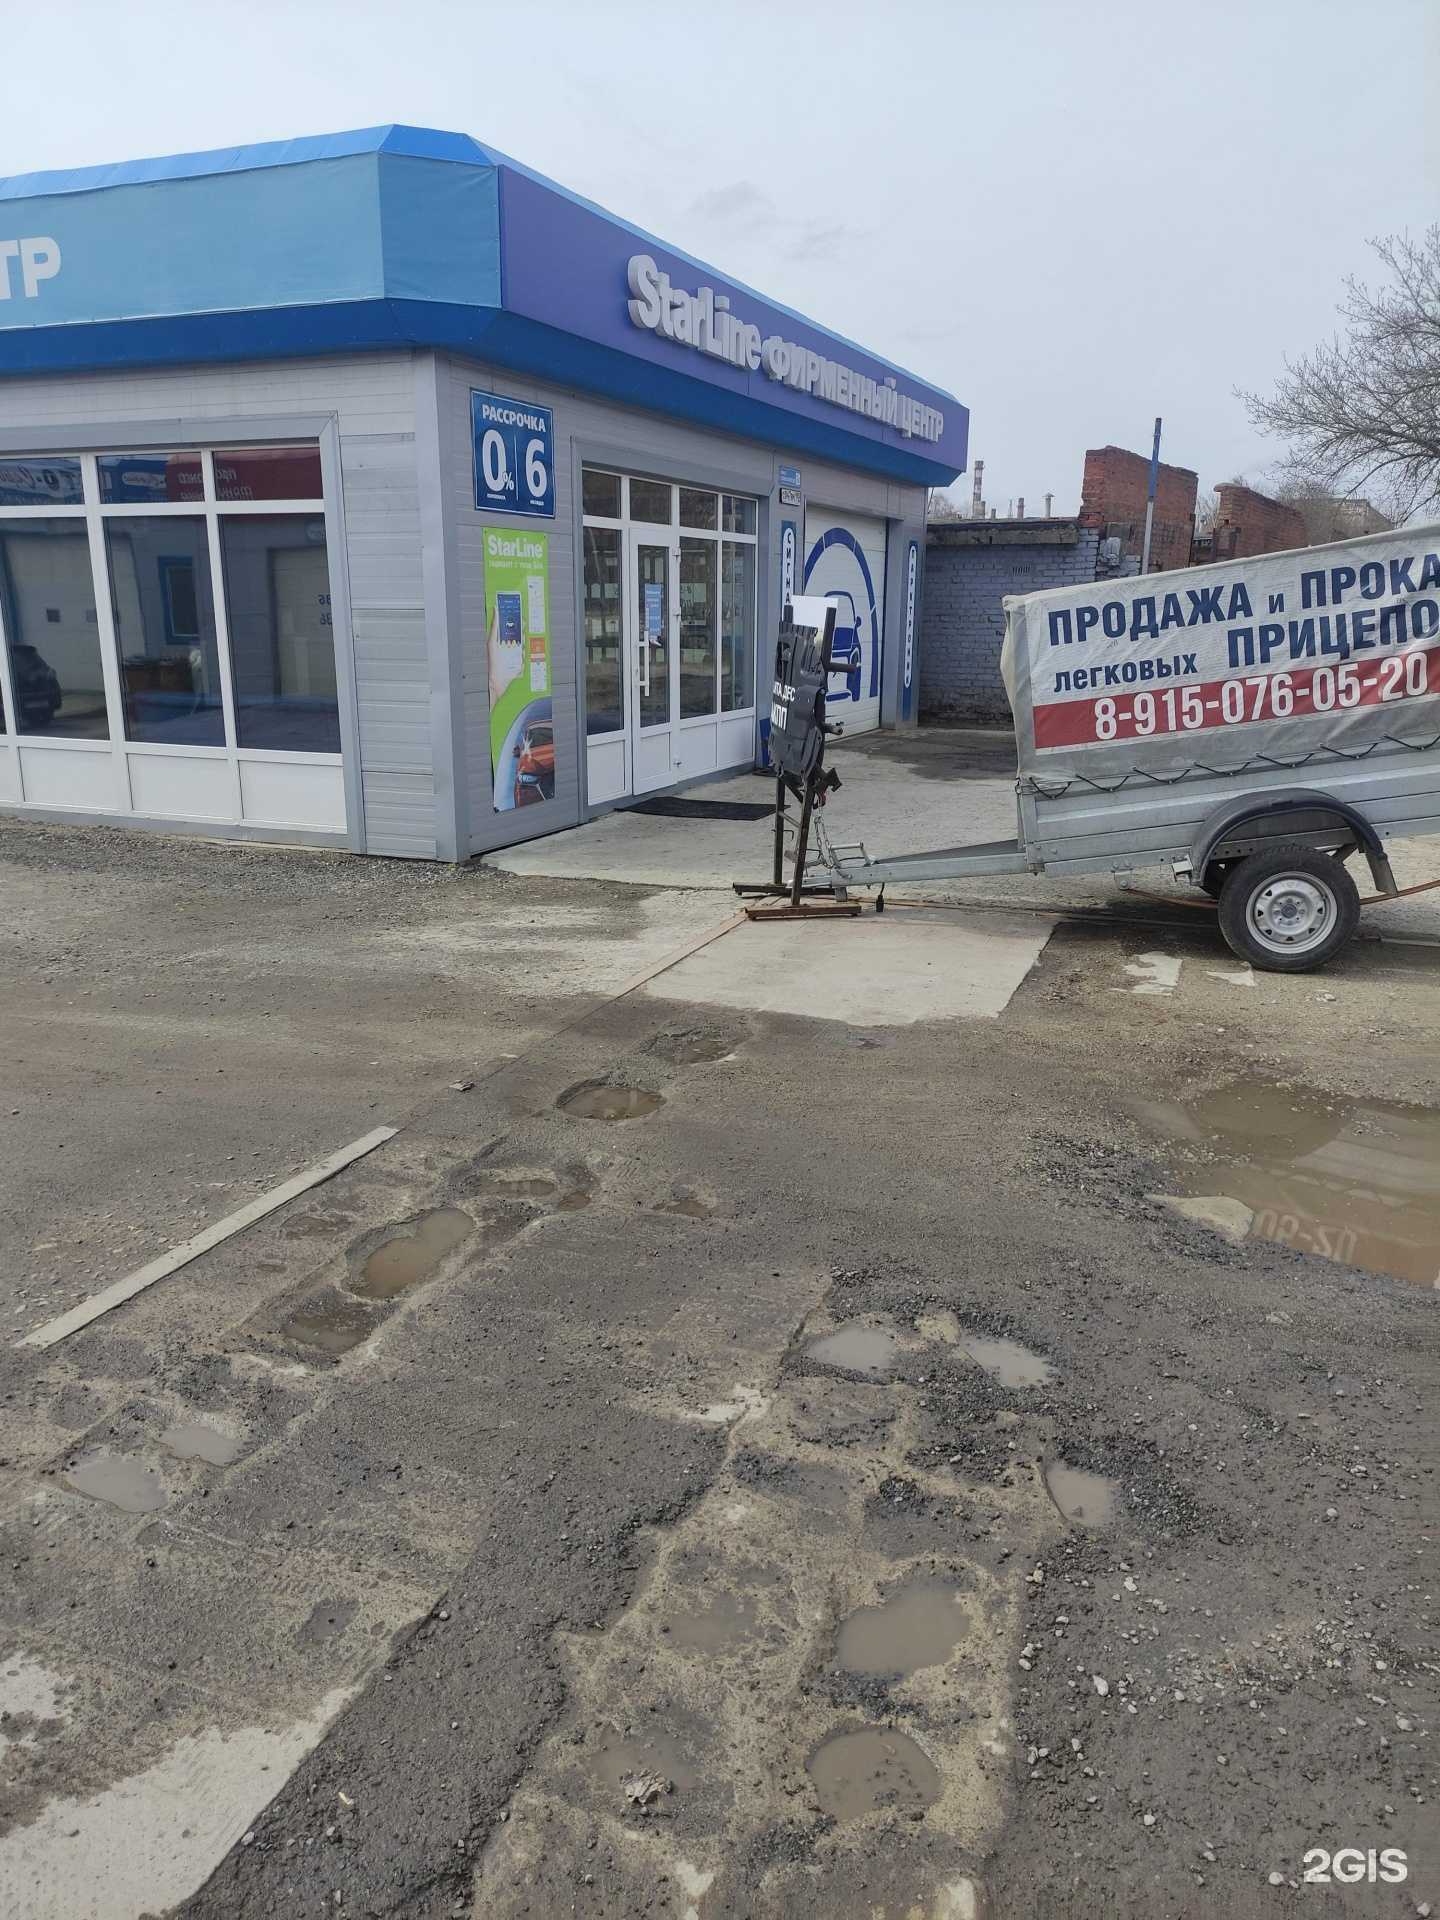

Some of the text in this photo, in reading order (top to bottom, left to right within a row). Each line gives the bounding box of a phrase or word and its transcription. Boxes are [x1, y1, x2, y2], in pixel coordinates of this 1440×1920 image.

[628, 254, 944, 443] StarLine ФИРМЕННЫЙ ЦЕНТР
[482, 404, 547, 433] РАССРОЧКА
[525, 438, 548, 498] 6
[487, 533, 544, 559] StarLine
[1048, 553, 1440, 646] ПРОДАЖА и ПРОКА
[1227, 599, 1440, 668] ПРИЦЕПО
[1093, 650, 1429, 741] 8-915-076-05-20
